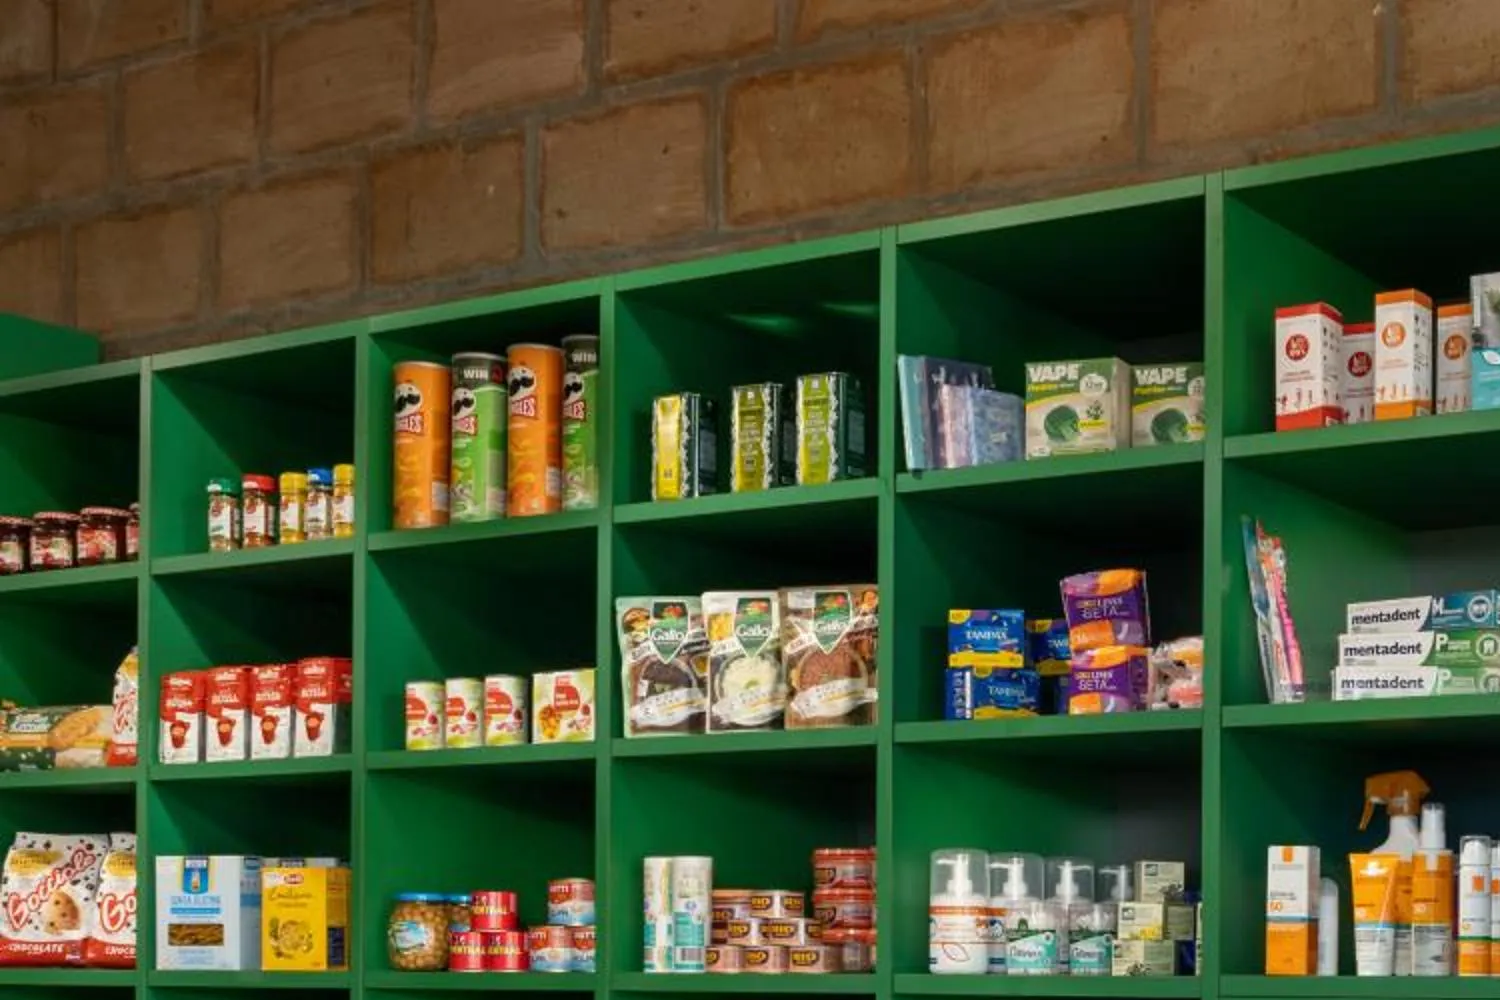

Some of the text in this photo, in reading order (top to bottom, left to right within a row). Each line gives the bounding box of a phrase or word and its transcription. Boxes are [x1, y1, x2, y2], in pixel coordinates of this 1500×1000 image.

[572, 352, 597, 363] WIN
[463, 369, 488, 380] WIN
[1029, 364, 1080, 382] VAPE
[1135, 368, 1188, 385] VAPE
[1352, 608, 1421, 625] mentadent
[736, 624, 769, 637] Gallo
[815, 619, 848, 633] Gallo
[651, 628, 683, 641] Gallo
[1344, 642, 1422, 656] mentadent
[1341, 676, 1424, 689] mentadent
[9, 943, 64, 953] CHOCOLATE
